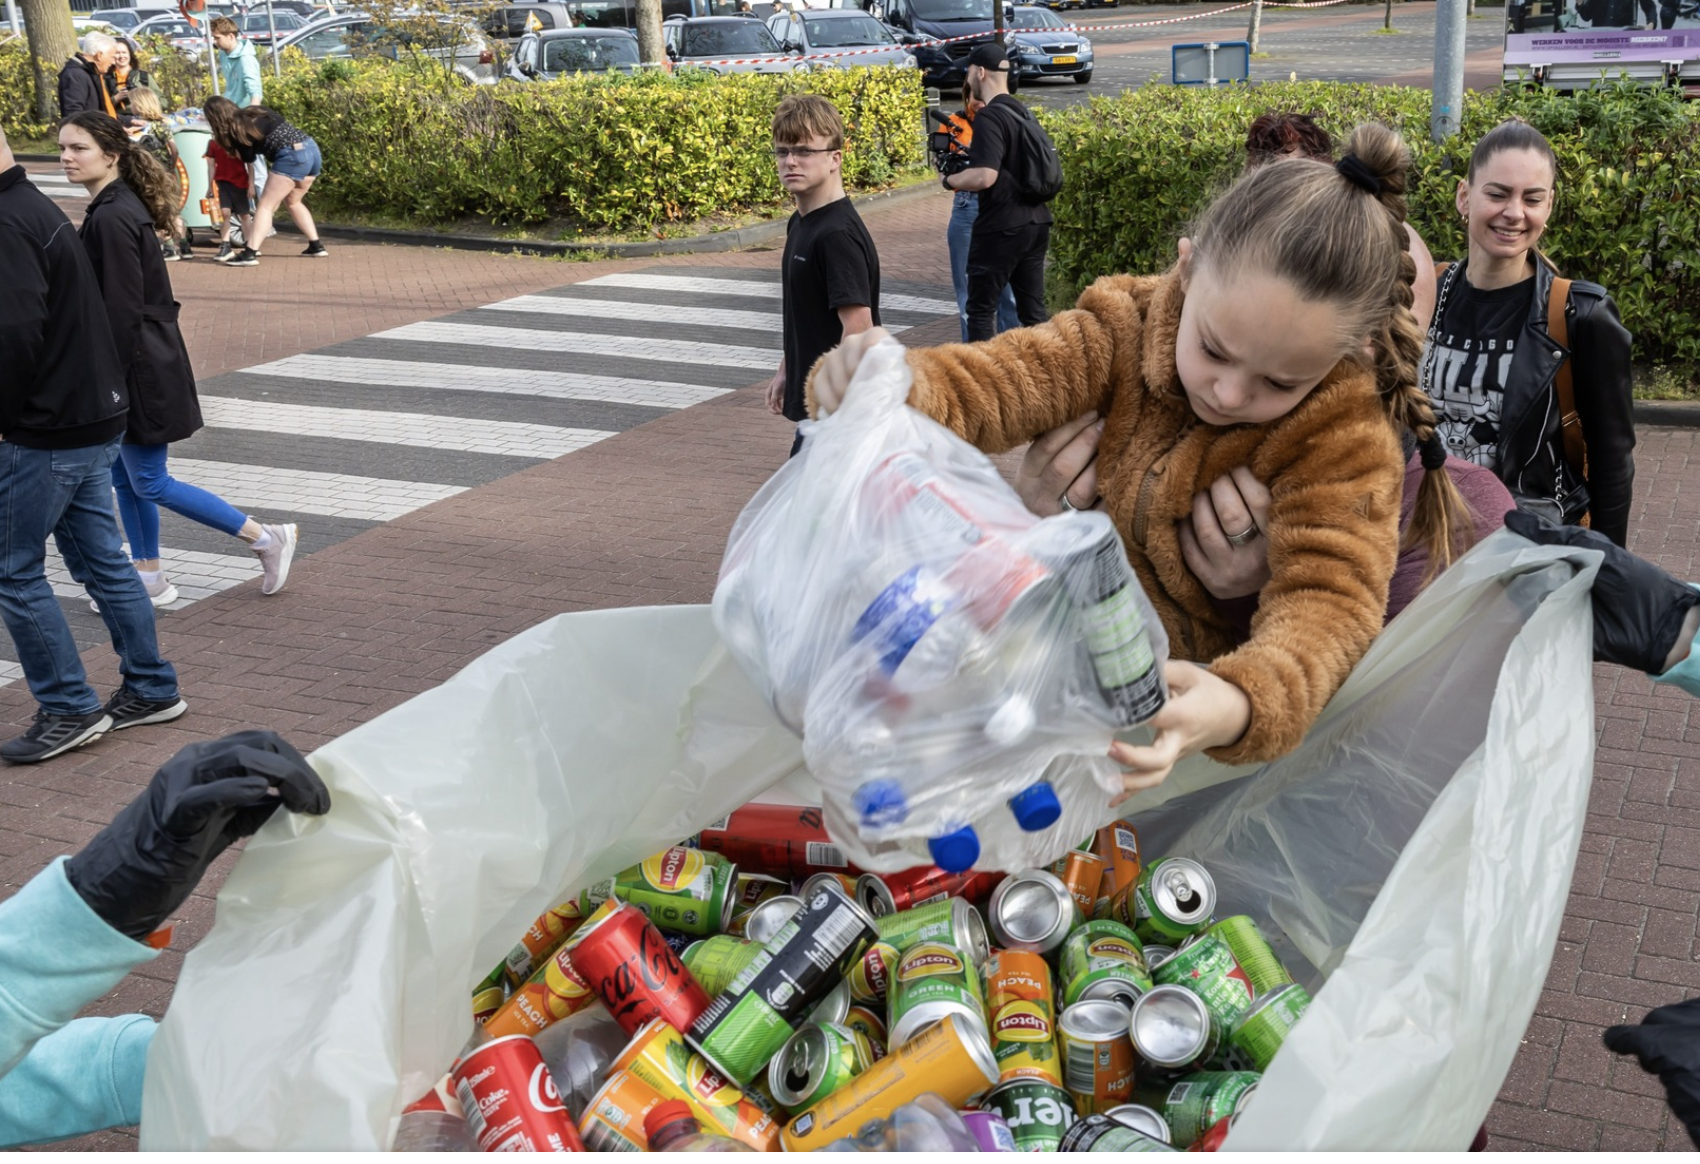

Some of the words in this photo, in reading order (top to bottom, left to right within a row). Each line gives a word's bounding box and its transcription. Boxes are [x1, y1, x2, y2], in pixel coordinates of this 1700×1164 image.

[663, 847, 685, 882] Lipton
[1073, 892, 1091, 905] PEA
[905, 957, 953, 972] Lipton
[997, 976, 1042, 990] PEACH
[909, 984, 954, 999] GREEN
[516, 993, 548, 1028] PEACH
[1000, 1015, 1046, 1031] Lipton
[748, 1113, 772, 1140] PEAC
